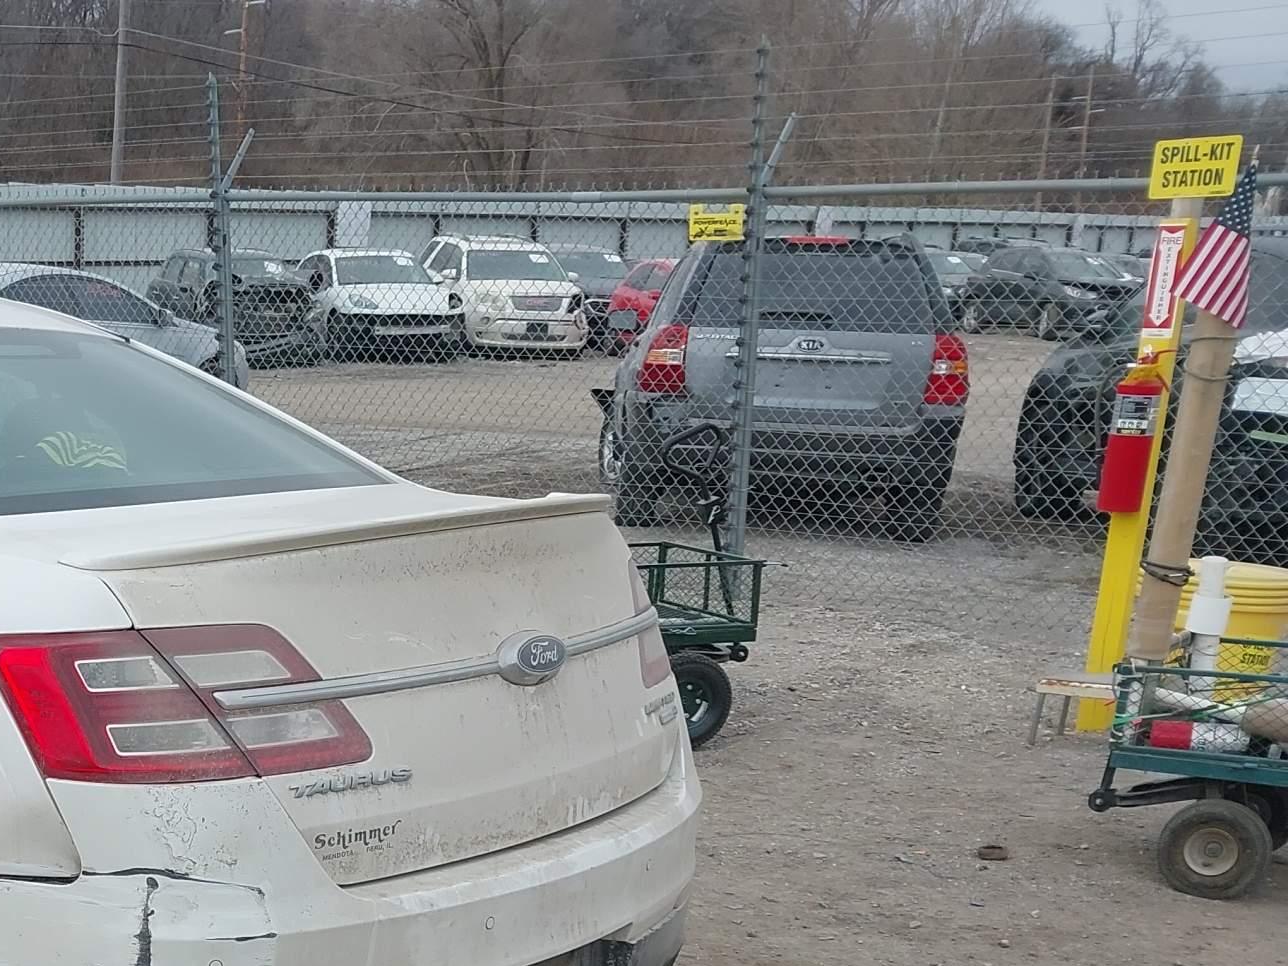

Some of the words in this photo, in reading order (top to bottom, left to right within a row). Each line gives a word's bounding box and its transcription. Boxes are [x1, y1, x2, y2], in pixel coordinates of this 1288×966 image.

[1160, 142, 1235, 164] SPILL-KIT
[1162, 167, 1224, 188] STATION
[1163, 236, 1183, 245] FIRE
[800, 341, 822, 350] KIA
[530, 641, 558, 666] Ford
[289, 768, 412, 799] TAURUS
[314, 819, 402, 850] Schimmer
